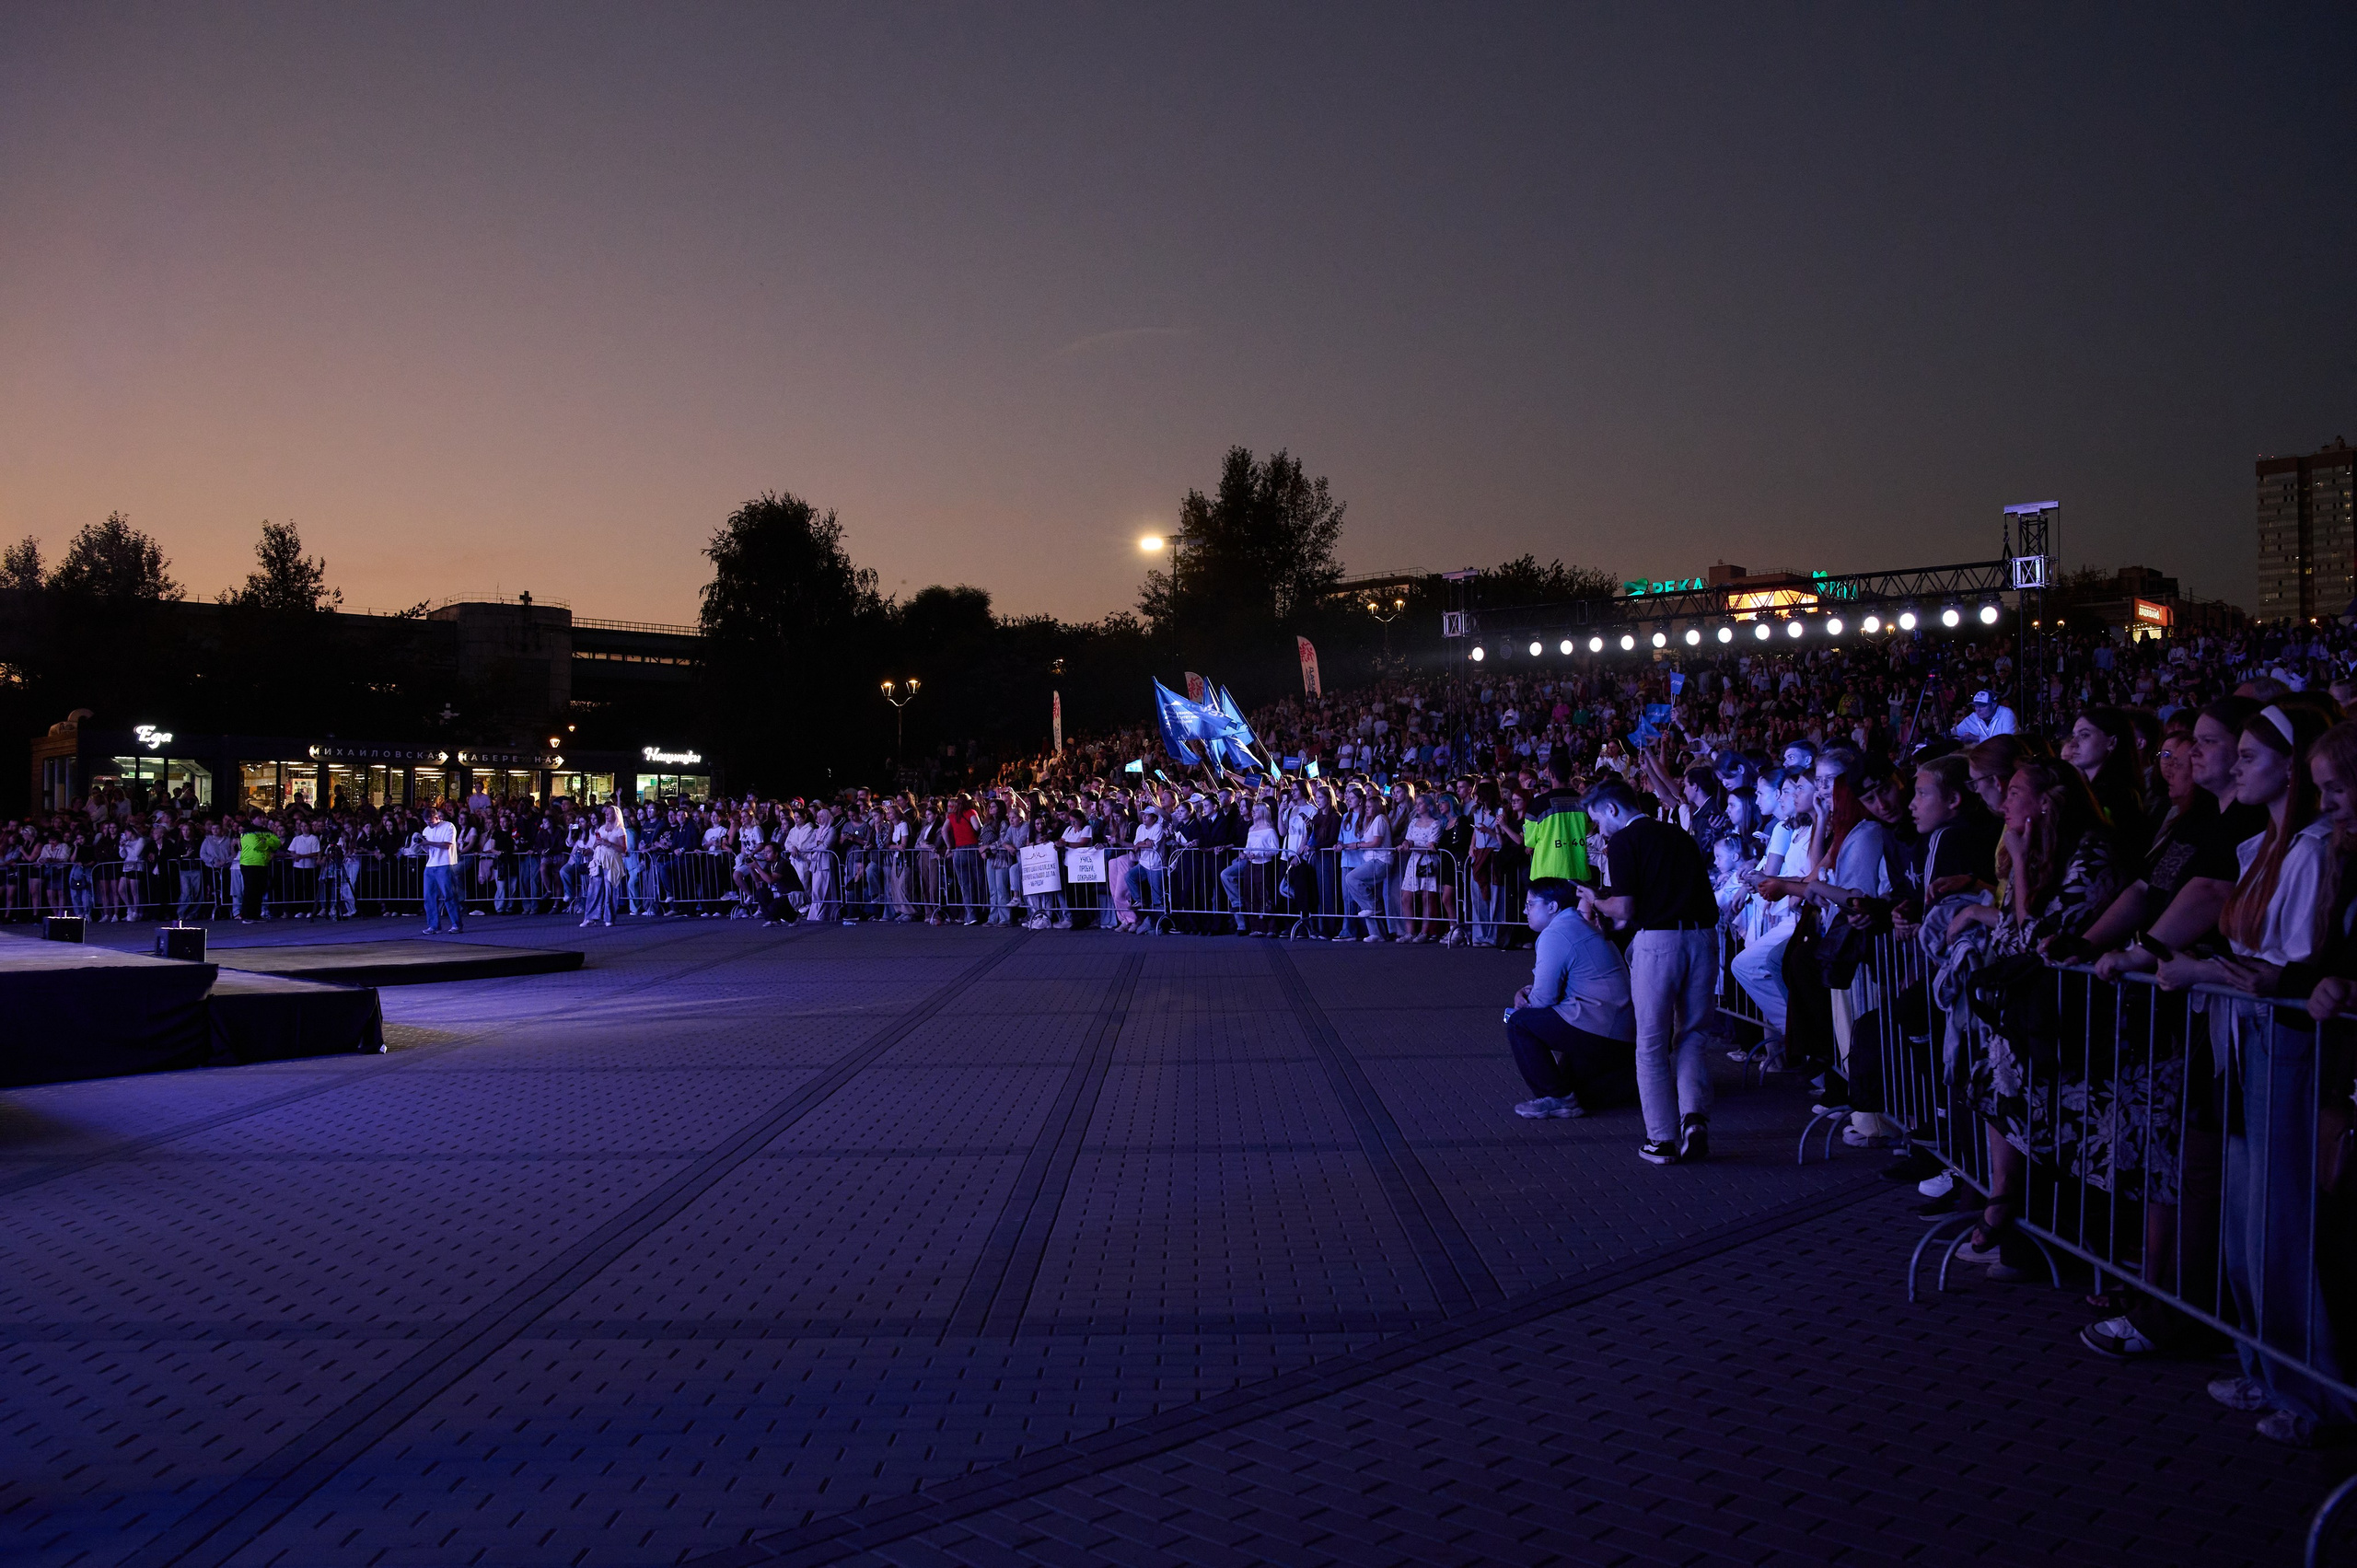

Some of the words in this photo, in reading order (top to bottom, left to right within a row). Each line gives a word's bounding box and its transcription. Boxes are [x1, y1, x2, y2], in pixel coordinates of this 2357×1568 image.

[1653, 577, 1703, 594] РЕКА
[311, 746, 444, 760] МИХАЙЛОВСКАЯ
[643, 747, 702, 764] Напитки
